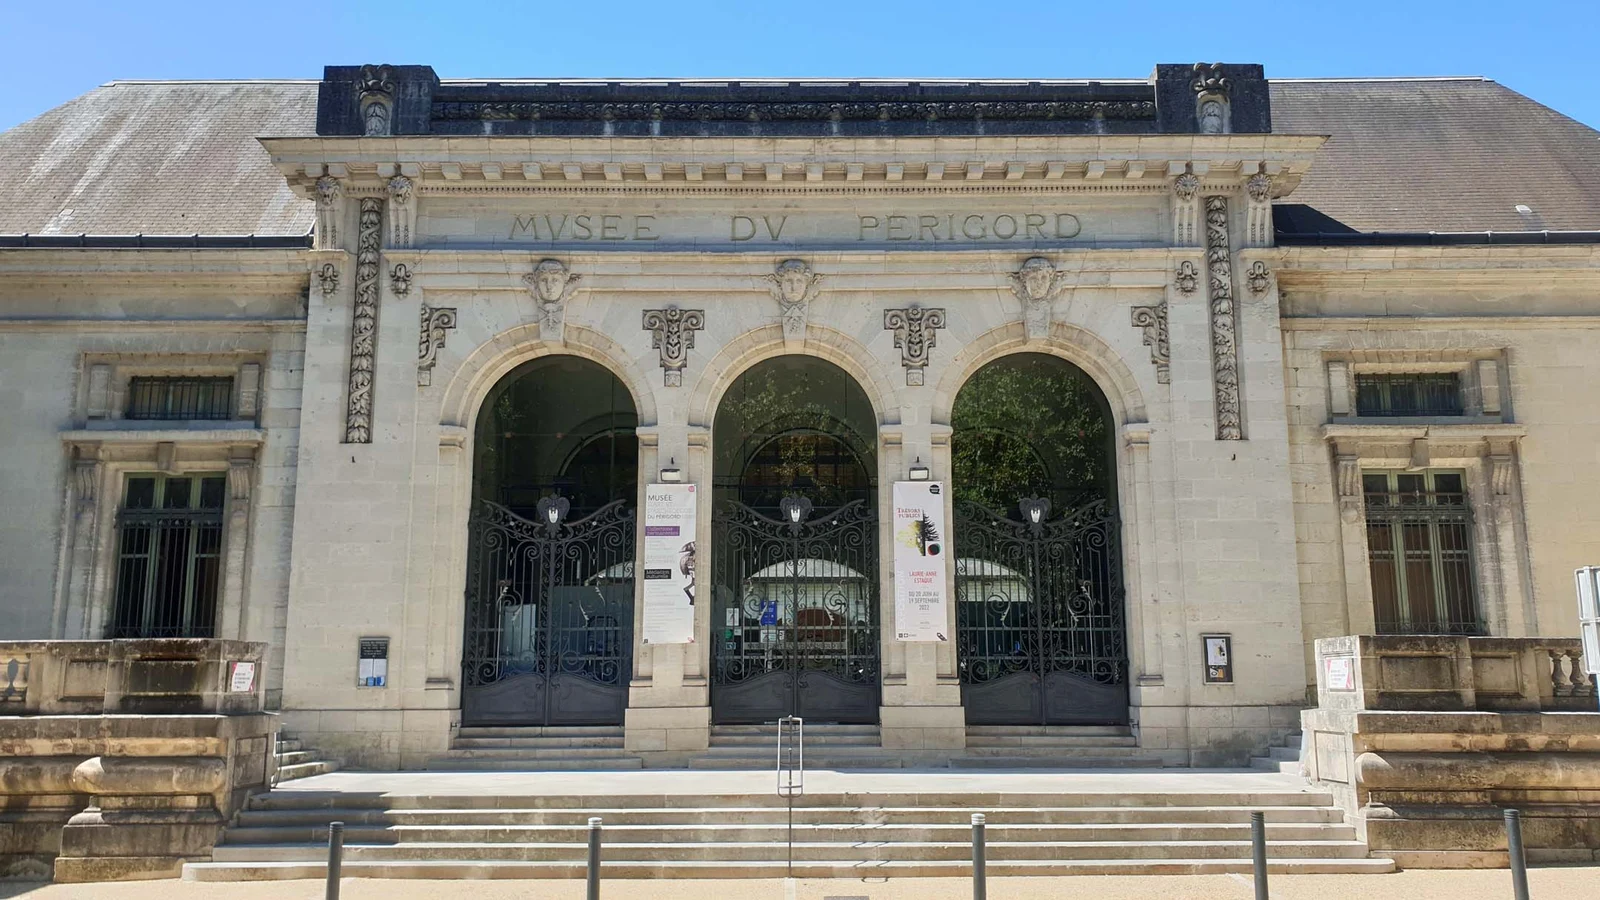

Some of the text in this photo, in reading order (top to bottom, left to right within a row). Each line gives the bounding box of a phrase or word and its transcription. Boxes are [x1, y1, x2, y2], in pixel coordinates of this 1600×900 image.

[508, 212, 1081, 241] MVSEE DV PERIGORD
